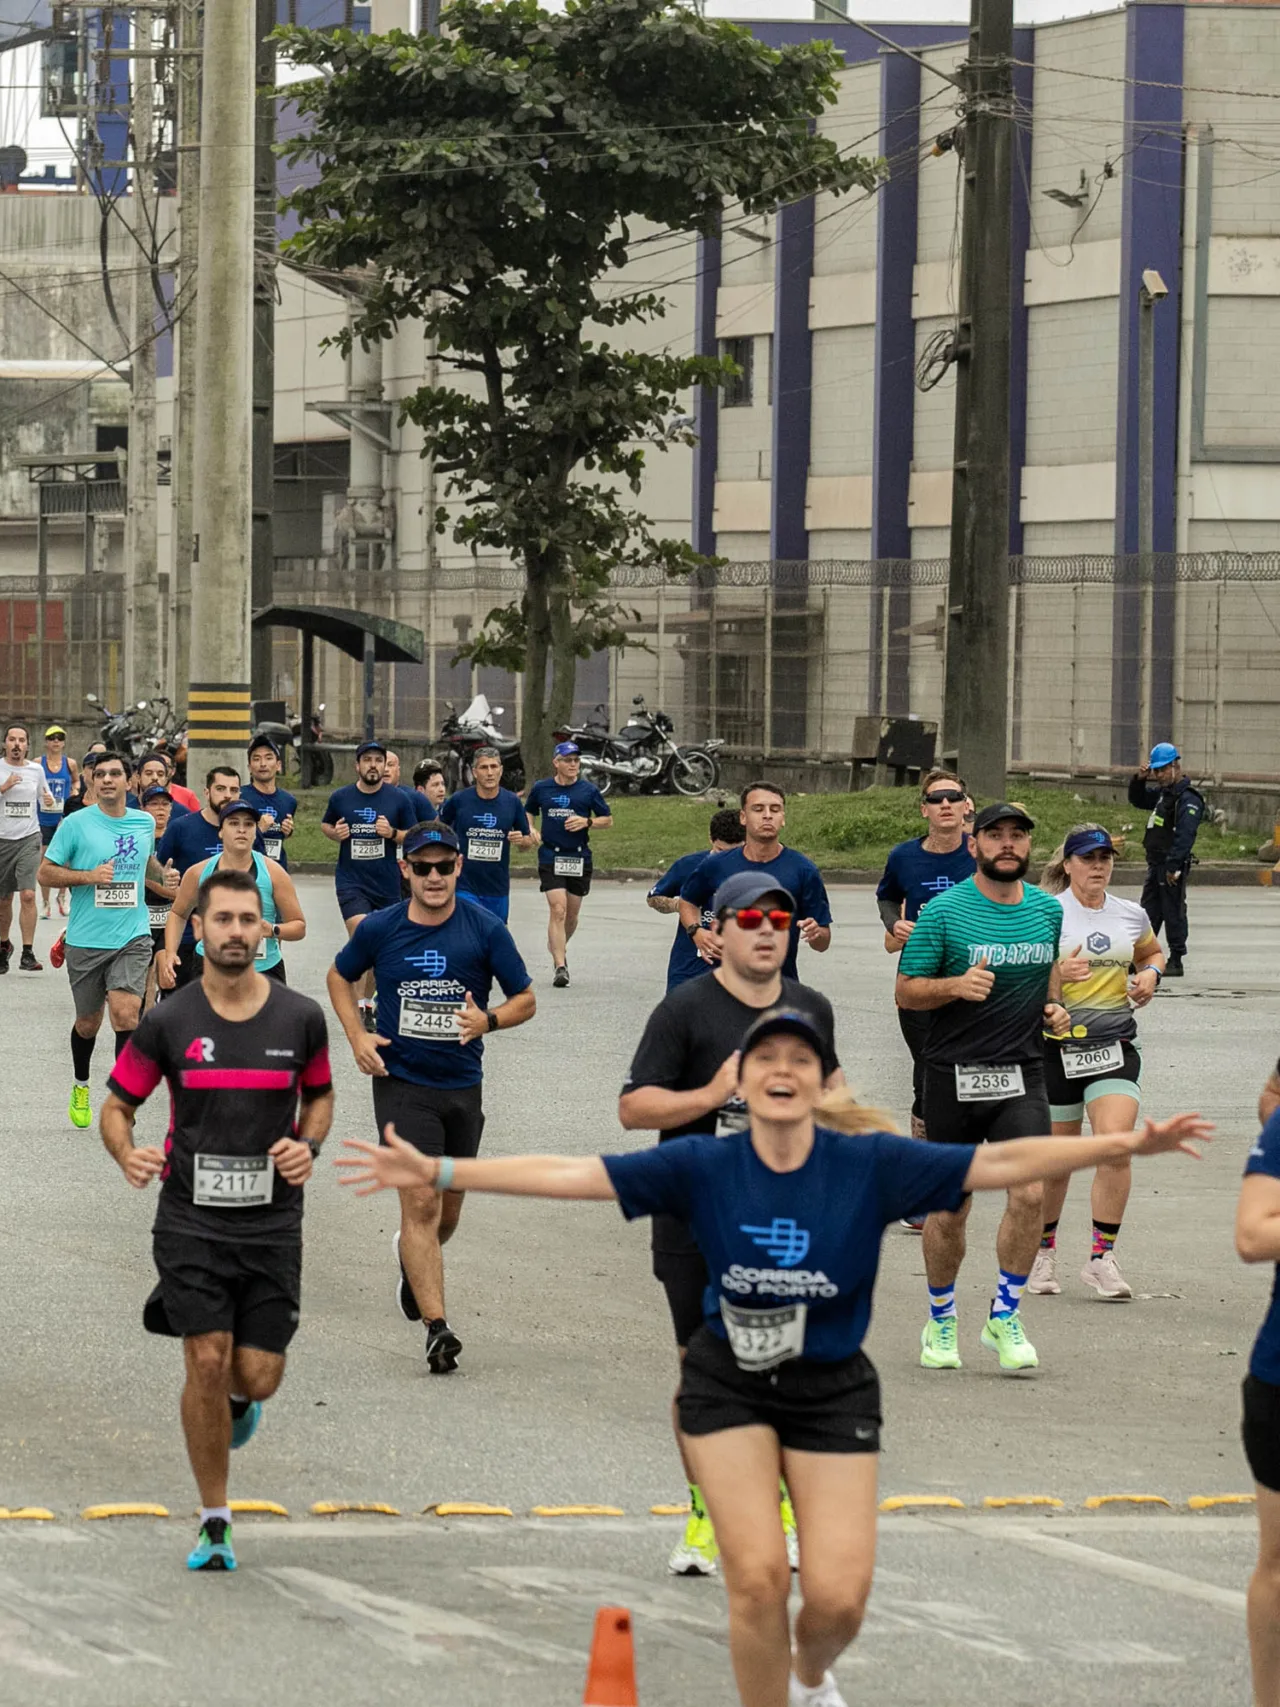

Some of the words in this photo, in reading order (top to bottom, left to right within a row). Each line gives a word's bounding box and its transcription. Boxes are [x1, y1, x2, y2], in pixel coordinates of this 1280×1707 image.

[358, 845, 379, 854] 2285
[475, 847, 496, 856] 2210
[104, 890, 130, 900] 2505
[397, 987, 417, 997] DO
[419, 985, 466, 997] PORTO
[400, 979, 461, 989] CORRIDA
[413, 1012, 453, 1029] 2445
[1074, 1049, 1111, 1067] 2060
[971, 1074, 1010, 1089] 2536
[212, 1173, 258, 1192] 2117
[728, 1263, 830, 1286] CORRIDA
[721, 1272, 753, 1295] DO
[756, 1282, 839, 1298] PORTO
